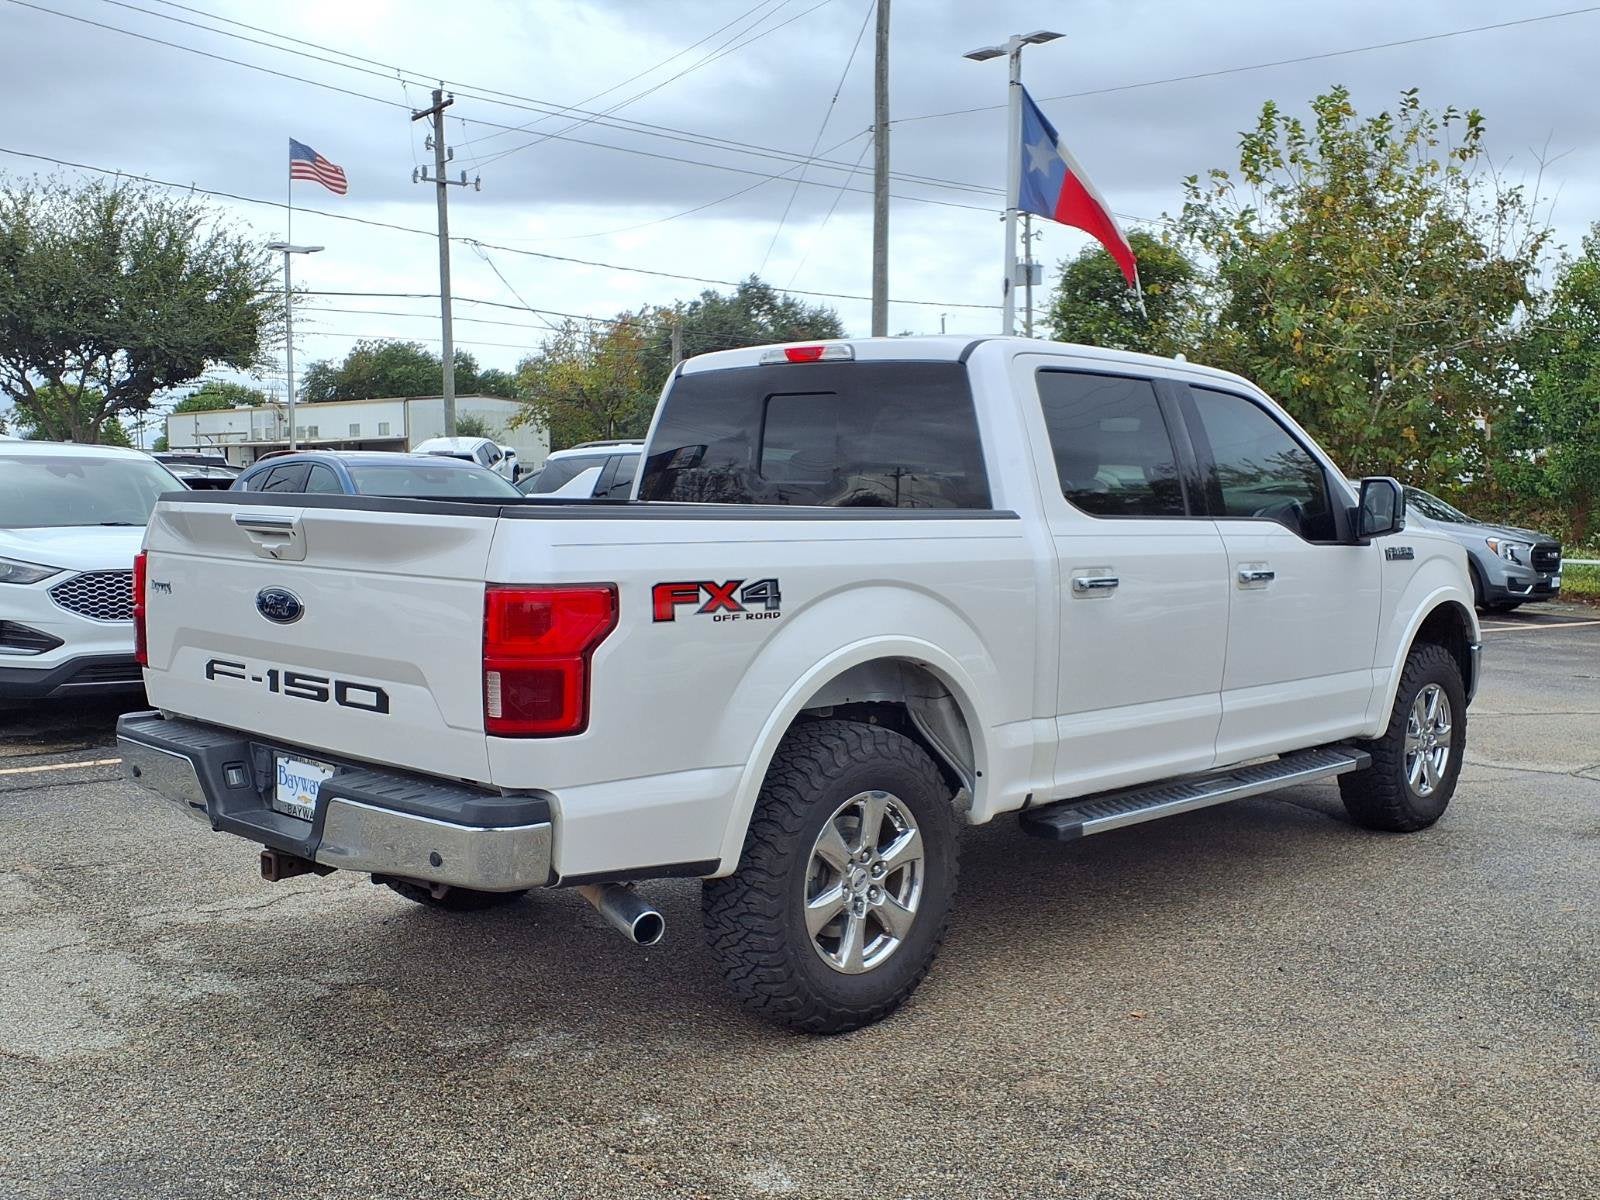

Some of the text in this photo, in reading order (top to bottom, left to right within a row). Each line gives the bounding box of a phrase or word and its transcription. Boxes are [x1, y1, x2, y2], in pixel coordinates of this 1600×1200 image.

[652, 578, 782, 623] FX4
[713, 612, 781, 622] OFF ROAD
[205, 658, 390, 715] F-150
